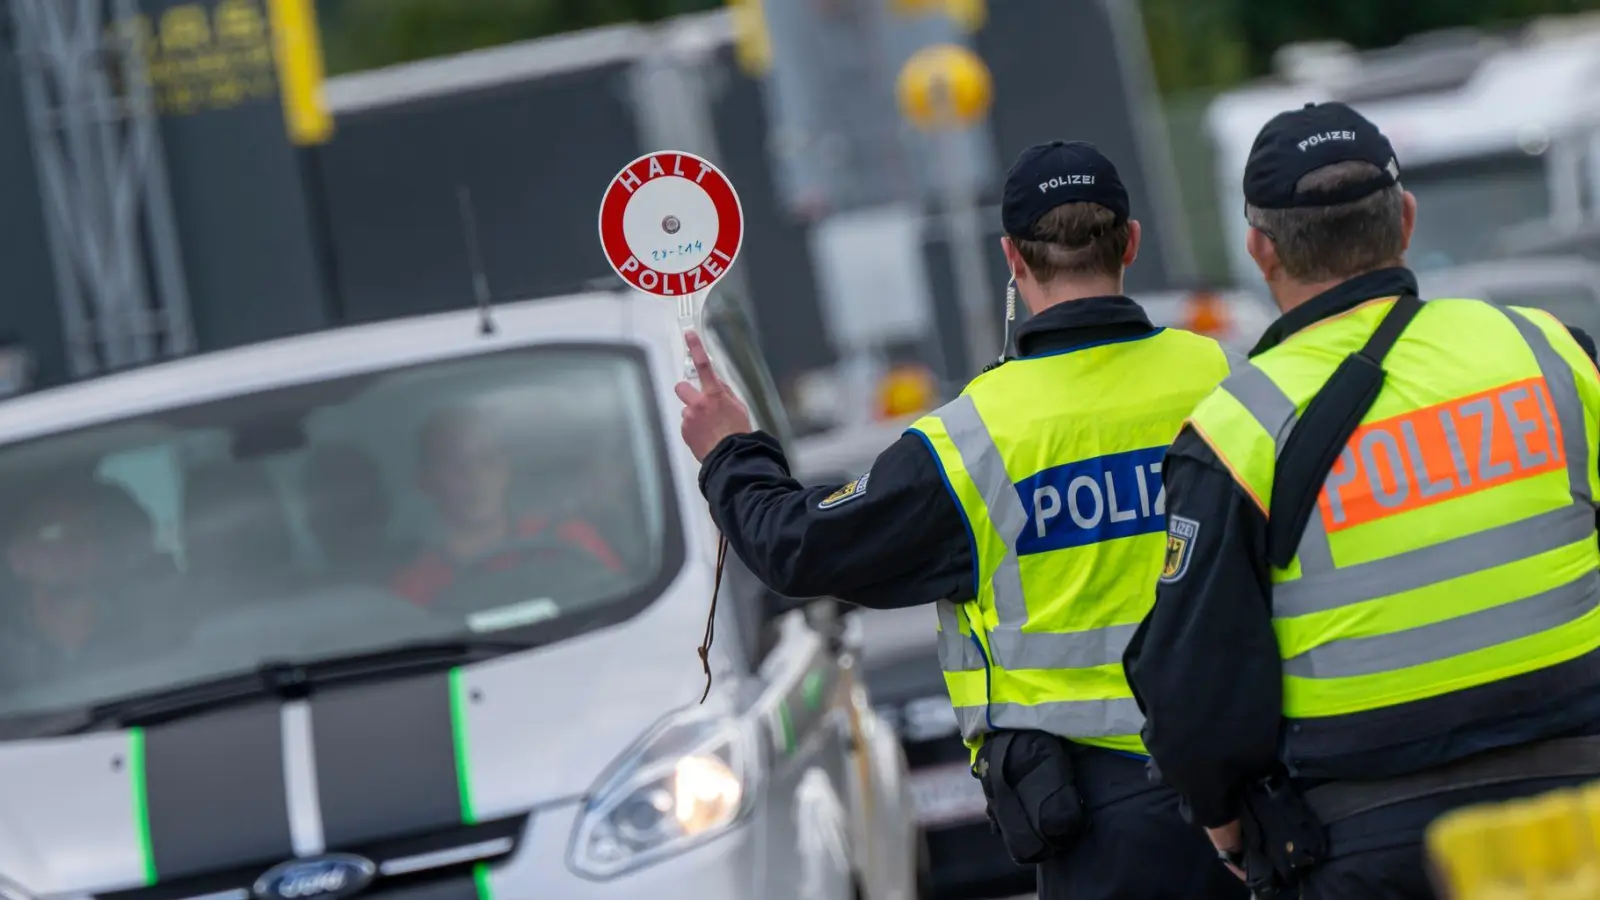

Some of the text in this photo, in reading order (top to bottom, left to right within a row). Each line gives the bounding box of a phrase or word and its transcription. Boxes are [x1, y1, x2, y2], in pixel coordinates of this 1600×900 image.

[1297, 130, 1356, 152] POLIZEI
[618, 155, 713, 194] HALT
[1038, 174, 1095, 193] POLIZEI
[618, 248, 732, 295] POLIZEI
[1323, 383, 1561, 524] POLIZEI
